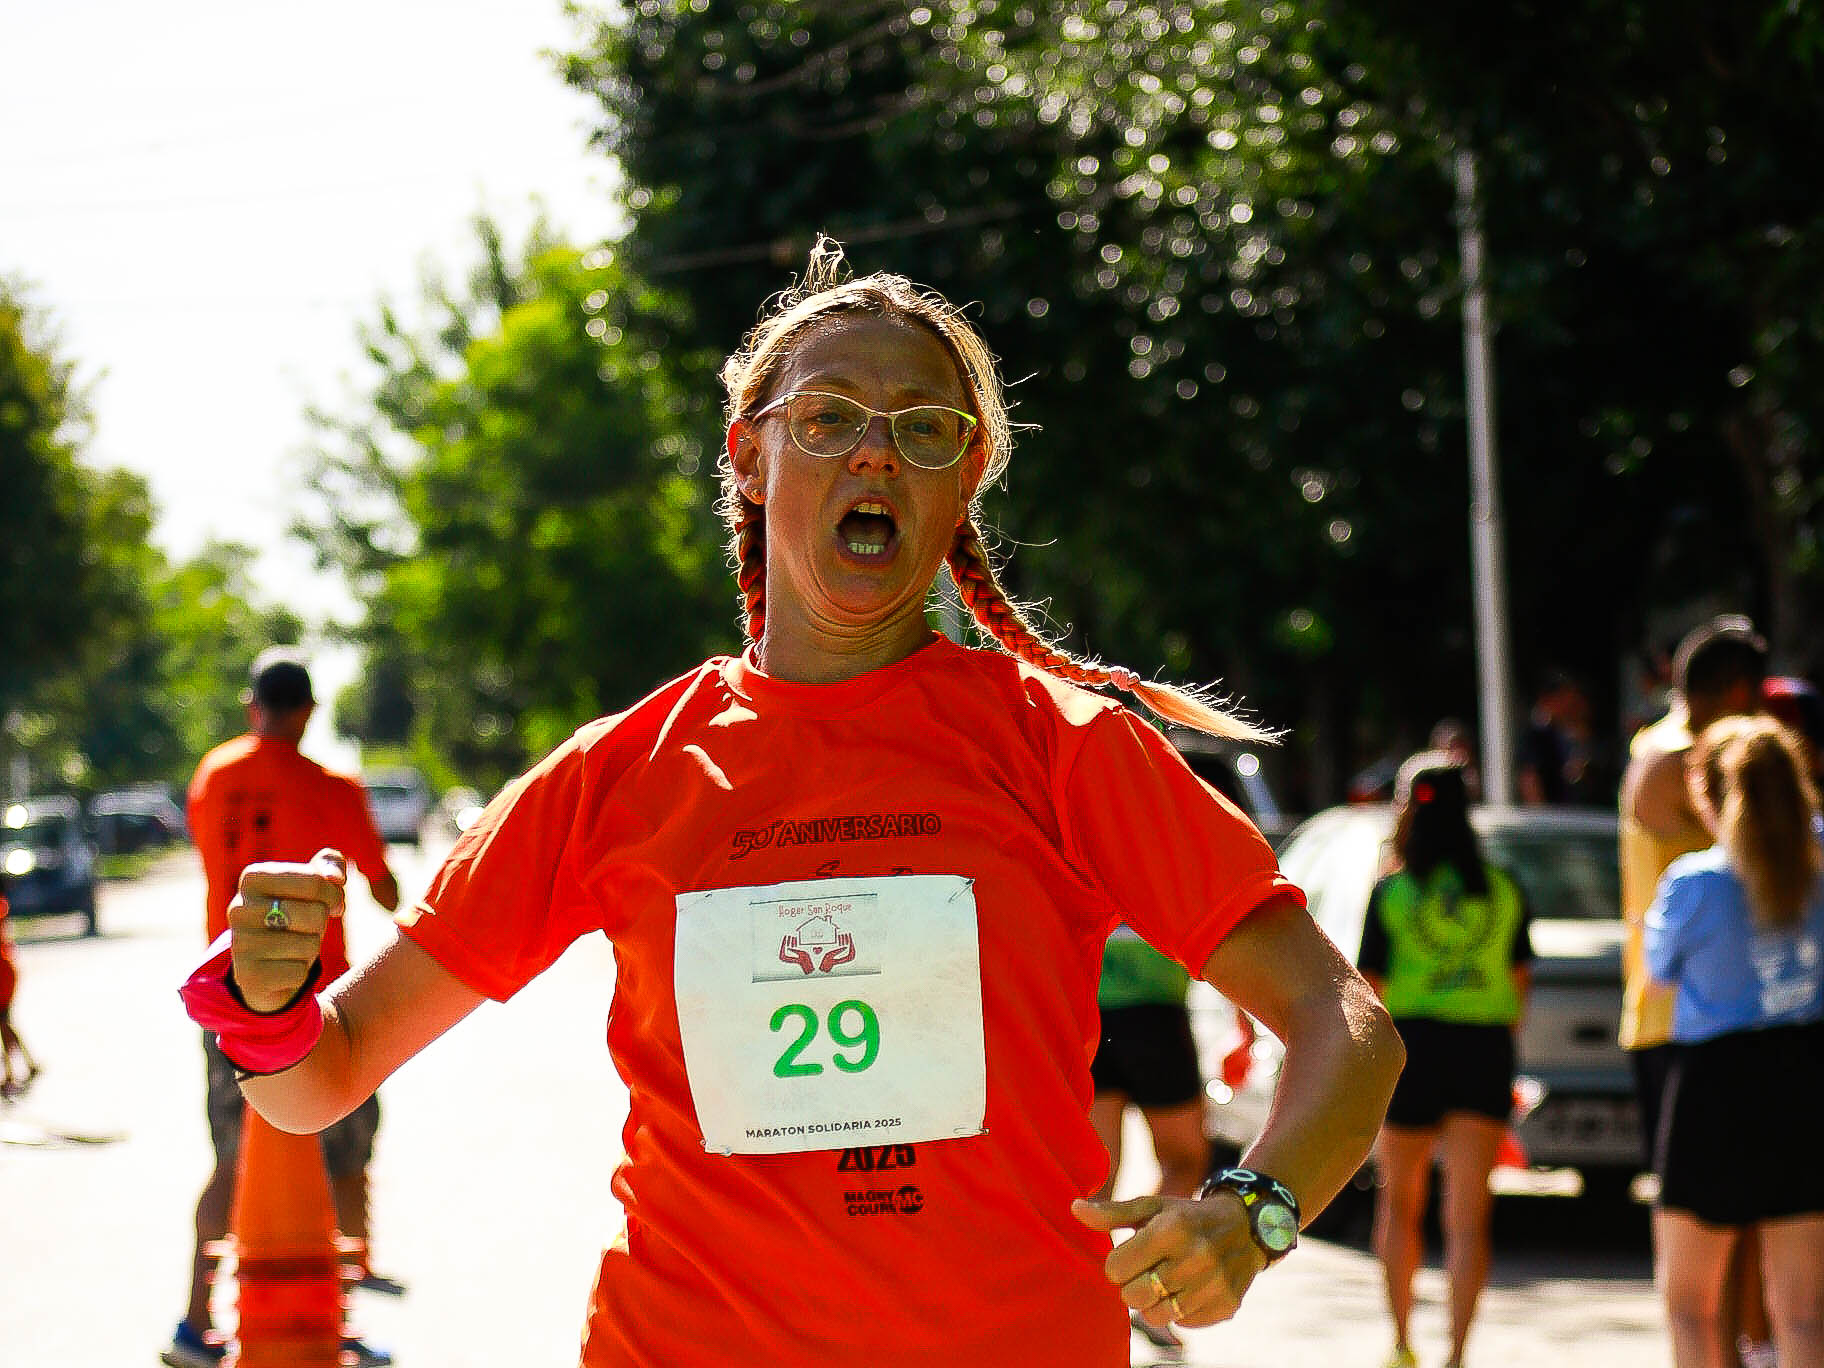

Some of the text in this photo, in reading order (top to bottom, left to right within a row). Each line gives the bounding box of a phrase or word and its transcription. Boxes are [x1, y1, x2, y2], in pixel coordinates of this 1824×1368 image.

[777, 813, 942, 847] ANIVERSARIO
[769, 1000, 881, 1079] 29
[746, 1118, 901, 1138] MARATON SOLIDARIA 2025
